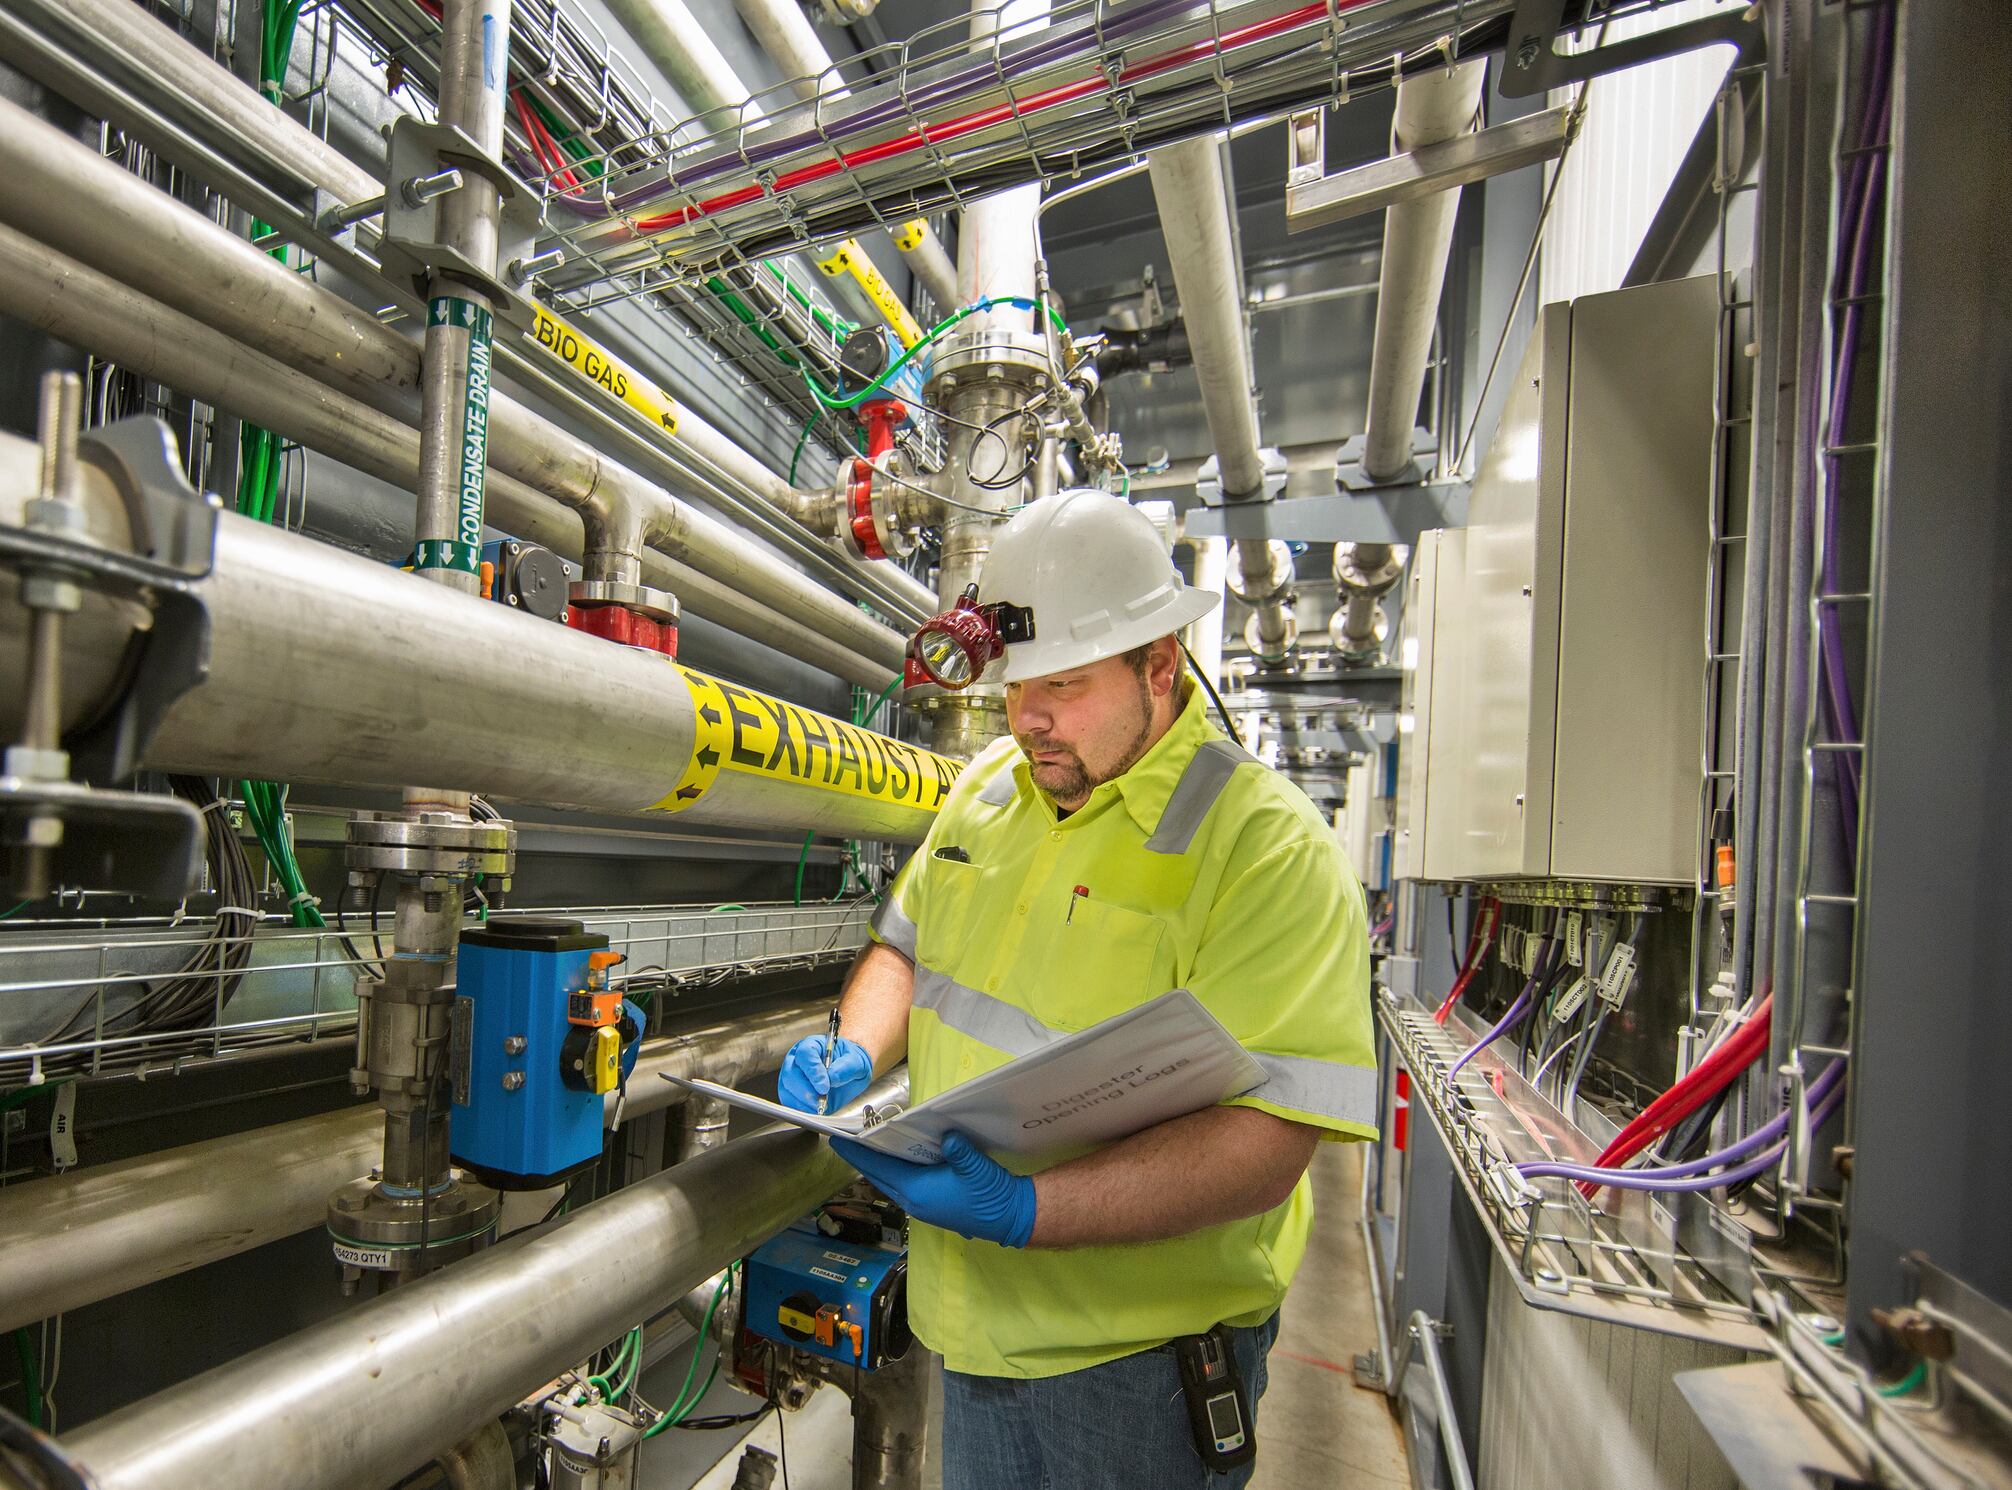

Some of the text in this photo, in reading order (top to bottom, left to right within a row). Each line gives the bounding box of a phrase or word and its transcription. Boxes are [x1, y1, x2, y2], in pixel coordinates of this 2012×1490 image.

[536, 316, 628, 399] BIO GAS
[461, 339, 490, 548] CONDENSATE DRAIN
[717, 682, 922, 803] EXHAUST
[57, 1114, 66, 1134] AIR
[1022, 1057, 1191, 1130] Opening Logs
[1041, 1064, 1144, 1112] Digester
